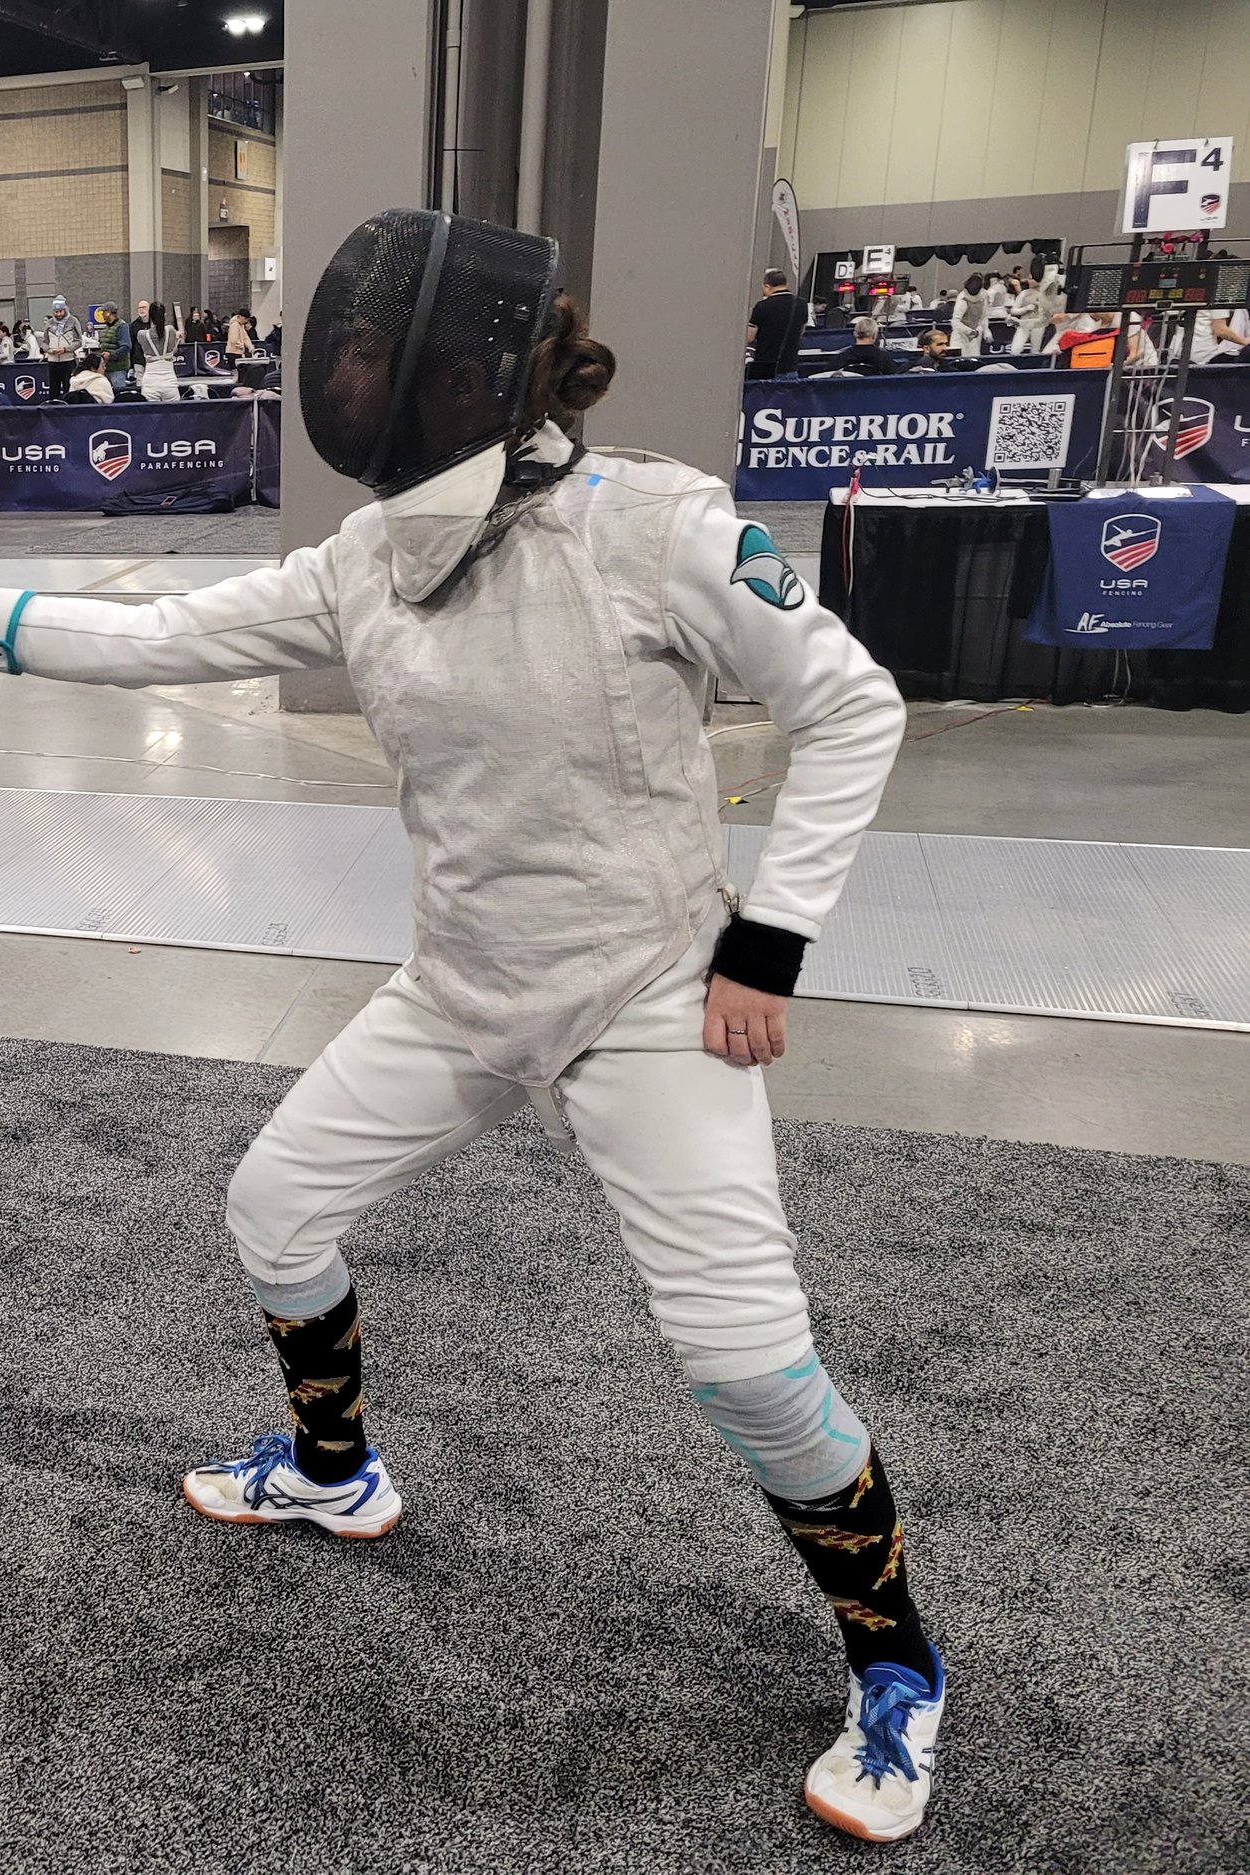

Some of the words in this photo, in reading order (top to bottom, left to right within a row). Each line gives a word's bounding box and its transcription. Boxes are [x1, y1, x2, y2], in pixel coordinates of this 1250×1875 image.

[1132, 149, 1197, 228] F
[1201, 148, 1223, 171] 4
[866, 249, 883, 271] E
[838, 265, 847, 277] D
[751, 408, 956, 443] SUPERIOR
[2, 445, 66, 461] USA
[147, 440, 216, 457] USA
[9, 464, 60, 472] FENCING
[140, 460, 224, 470] PARAFENCING
[1099, 579, 1148, 589] USA
